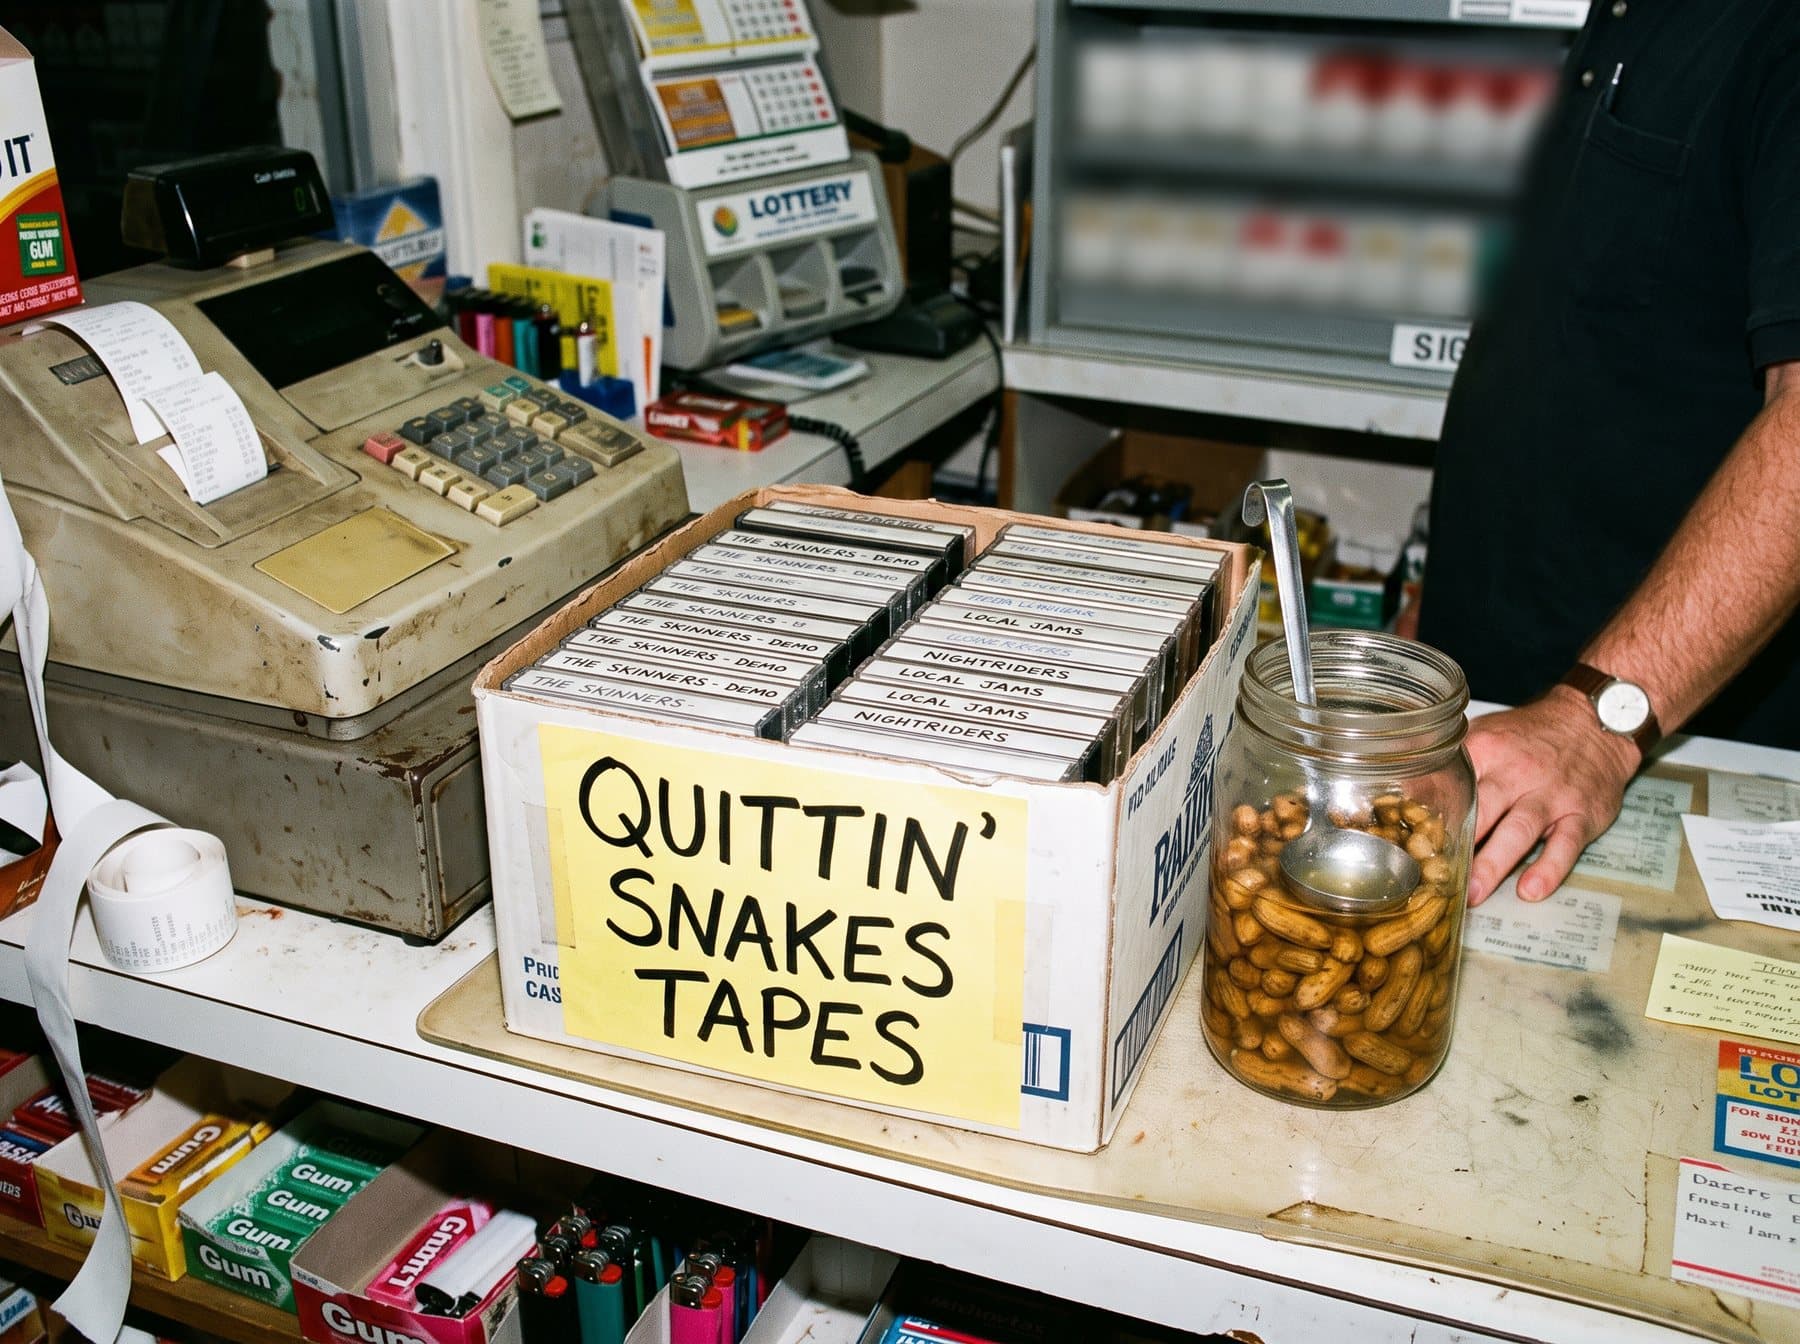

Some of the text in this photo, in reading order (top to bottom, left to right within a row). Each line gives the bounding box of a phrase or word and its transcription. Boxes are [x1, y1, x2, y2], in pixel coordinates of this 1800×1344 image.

[0, 135, 33, 178] IT
[750, 180, 851, 219] LOTTERY
[712, 549, 739, 560] THE
[754, 554, 837, 574] SKINNERS
[853, 569, 898, 582] DEMO
[732, 534, 762, 545] THE
[769, 540, 857, 559] SKINNERS
[873, 553, 920, 567] DEMO
[670, 581, 700, 592] THE
[715, 588, 797, 607] SKINNERS
[641, 598, 676, 609] THE
[687, 604, 776, 624] SKINNERS
[962, 611, 1085, 637] LOCAL JAMS
[617, 614, 655, 627] THE
[660, 620, 752, 643] SKINNERS
[768, 637, 818, 653] DEMO
[588, 633, 625, 646] THE
[628, 640, 717, 662] SKINNERS
[734, 653, 788, 674] DEMO
[923, 650, 1071, 680] NIGHTRIDERS
[533, 675, 572, 690] THE
[578, 682, 682, 710] SKINNERS
[562, 655, 600, 669] THE
[606, 662, 709, 688] SKINNERS
[723, 682, 778, 699] DEMO
[899, 667, 1045, 698] LOCAL JAMS
[886, 690, 1030, 721] LOCAL JAMS
[854, 710, 1009, 744] NIGHTRIDERS
[606, 867, 954, 998] SNAKES
[634, 968, 924, 1086] TAPES
[1730, 1106, 1760, 1119] FOR
[291, 1163, 354, 1194] Gum
[266, 1189, 330, 1222] Gum
[227, 1217, 292, 1250] Gum
[199, 1244, 272, 1290] Gum
[320, 1301, 428, 1344] Gum
